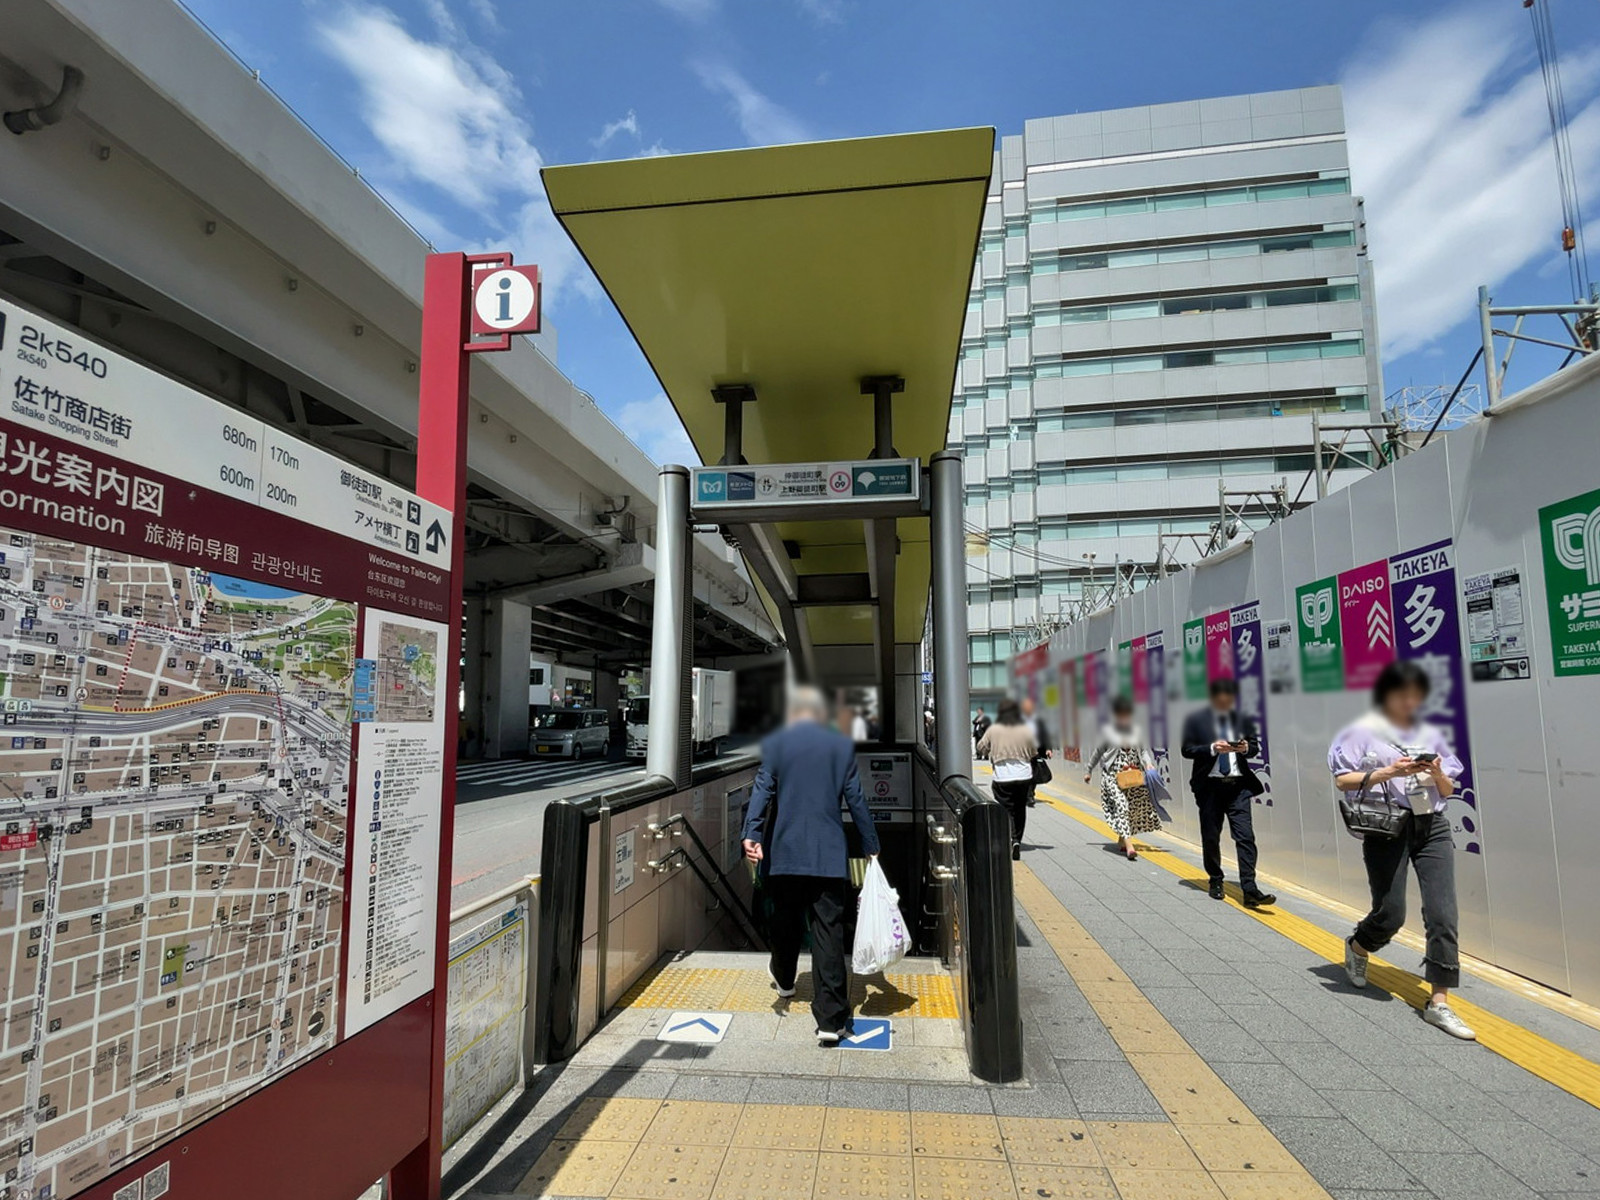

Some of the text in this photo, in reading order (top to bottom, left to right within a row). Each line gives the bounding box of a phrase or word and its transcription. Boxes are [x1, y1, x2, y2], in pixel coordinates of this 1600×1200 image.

[16, 349, 48, 369] 2k540
[20, 325, 107, 379] 2k540
[14, 375, 133, 440] 佐竹商店街
[11, 400, 119, 448] Satake Shopping Street
[222, 424, 257, 453] 680m
[270, 445, 300, 471] 170m
[220, 465, 255, 492] 600m
[340, 468, 382, 502] 御徒町駅
[762, 484, 772, 492] 17
[834, 481, 845, 489] 09
[266, 482, 298, 508] 200m
[354, 509, 402, 540] アメヤ横丁
[144, 521, 240, 566] 旅游向导图
[251, 551, 324, 585] 관광안내도
[368, 552, 401, 572] Welcome
[401, 564, 410, 574] to
[410, 566, 427, 580] Taito
[1393, 550, 1450, 581] TAKEYA
[1342, 575, 1385, 600] DAISO
[1206, 620, 1228, 636] DAISO
[1232, 607, 1259, 625] TAKEYA
